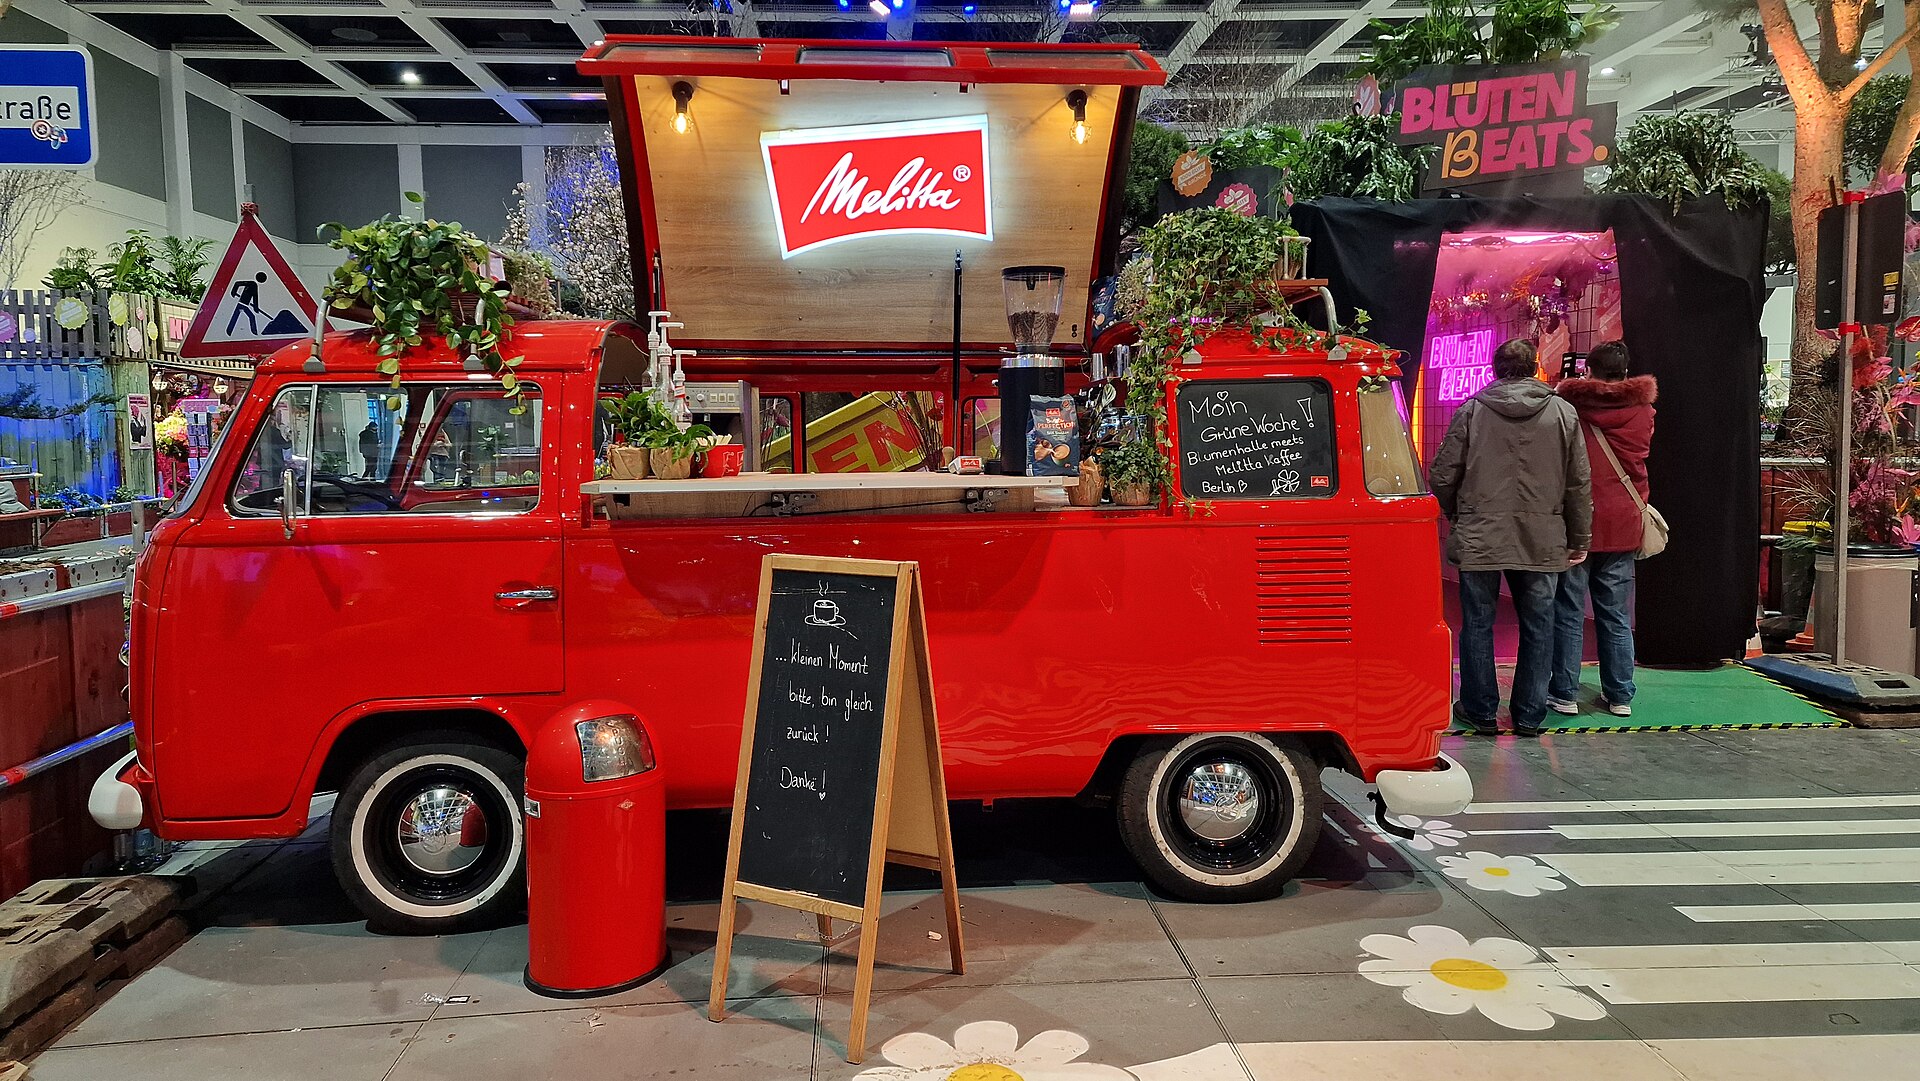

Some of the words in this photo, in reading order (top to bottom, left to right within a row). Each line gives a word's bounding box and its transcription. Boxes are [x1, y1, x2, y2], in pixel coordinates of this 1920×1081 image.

[1400, 69, 1577, 135] BLÜTEN
[1441, 118, 1609, 179] BEATS.
[1429, 329, 1492, 369] BLÜTEN
[1188, 390, 1248, 423] Moin
[811, 408, 923, 473] EN
[1200, 425, 1253, 443] Grüne
[1250, 413, 1300, 434] Woche
[1187, 440, 1268, 466] Blumenhalle
[1271, 434, 1304, 449] meets
[1215, 458, 1263, 476] Melitta
[1202, 481, 1235, 493] Berlin
[790, 637, 823, 667] kleinen
[829, 643, 869, 675] Moment
[789, 680, 815, 708] bitte,
[821, 686, 837, 707] bin
[845, 690, 874, 722] gleich
[786, 724, 819, 743] zurück
[825, 724, 830, 743] !
[822, 769, 827, 789] !
